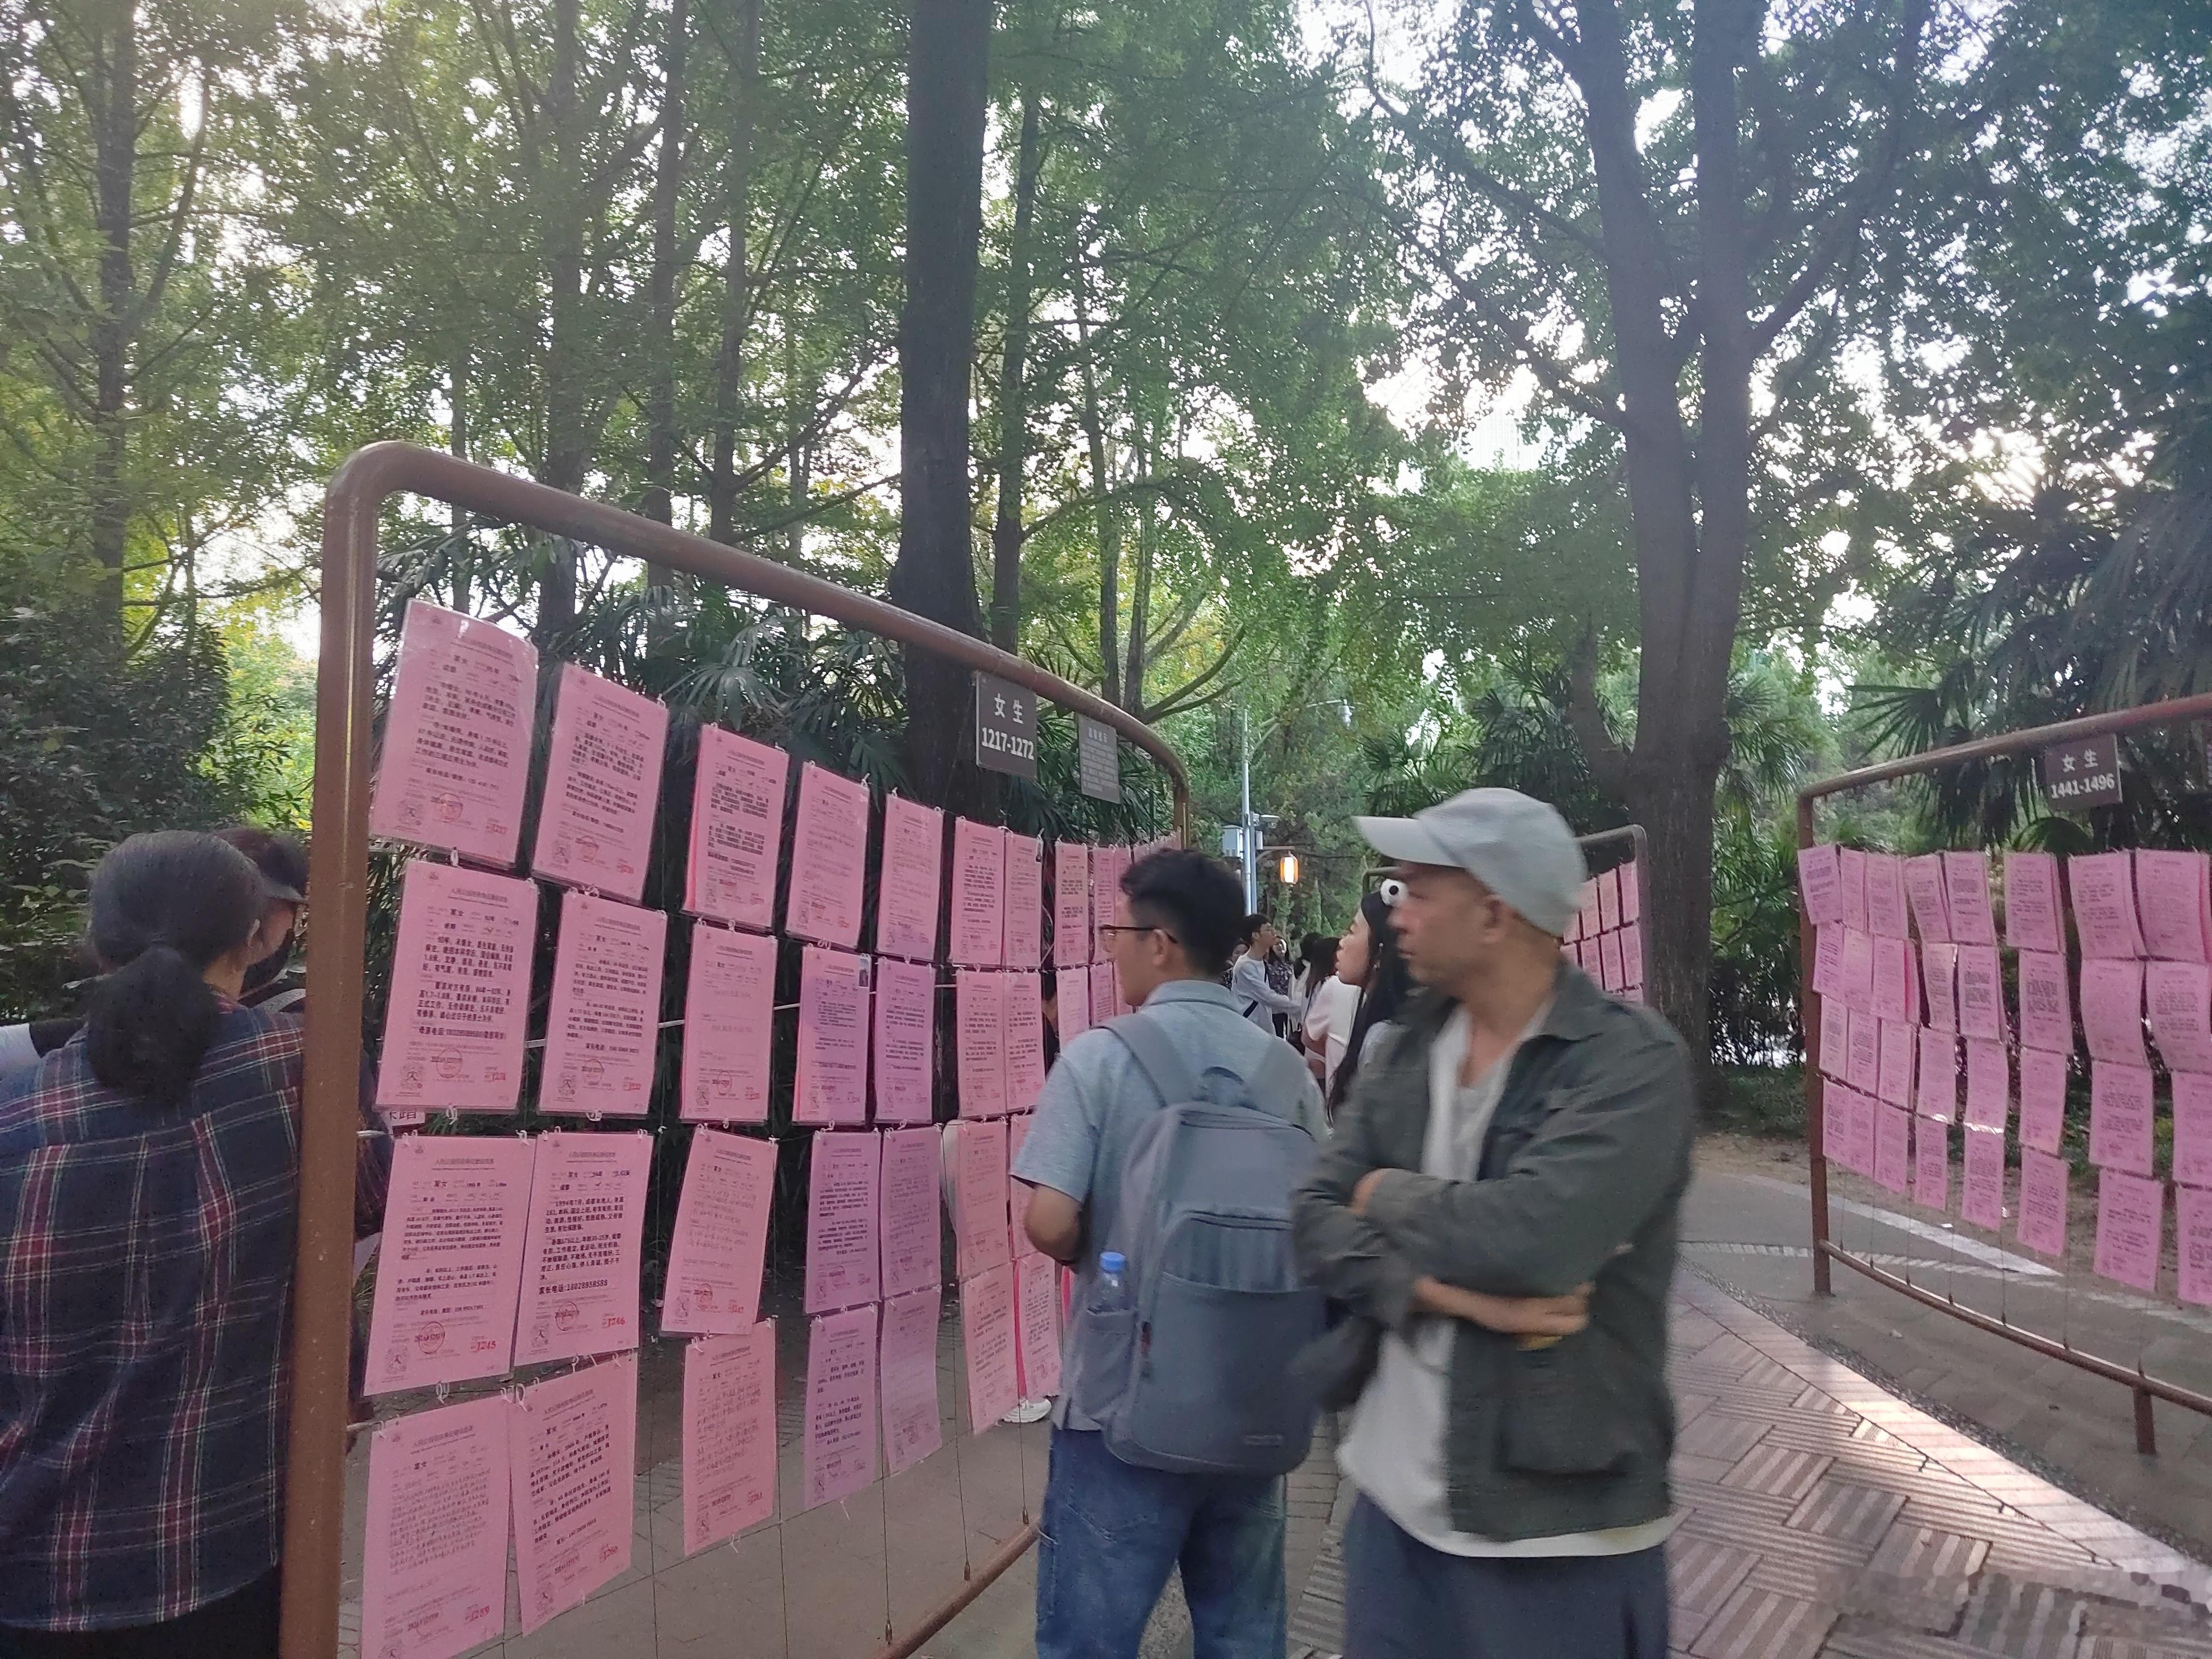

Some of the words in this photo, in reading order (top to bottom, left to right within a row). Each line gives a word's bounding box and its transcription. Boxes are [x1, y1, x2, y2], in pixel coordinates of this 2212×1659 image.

[993, 693, 1024, 725] 女生
[981, 727, 1035, 760] 1217-1272
[2061, 748, 2099, 773] 女生
[2051, 773, 2116, 799] 1441-1496
